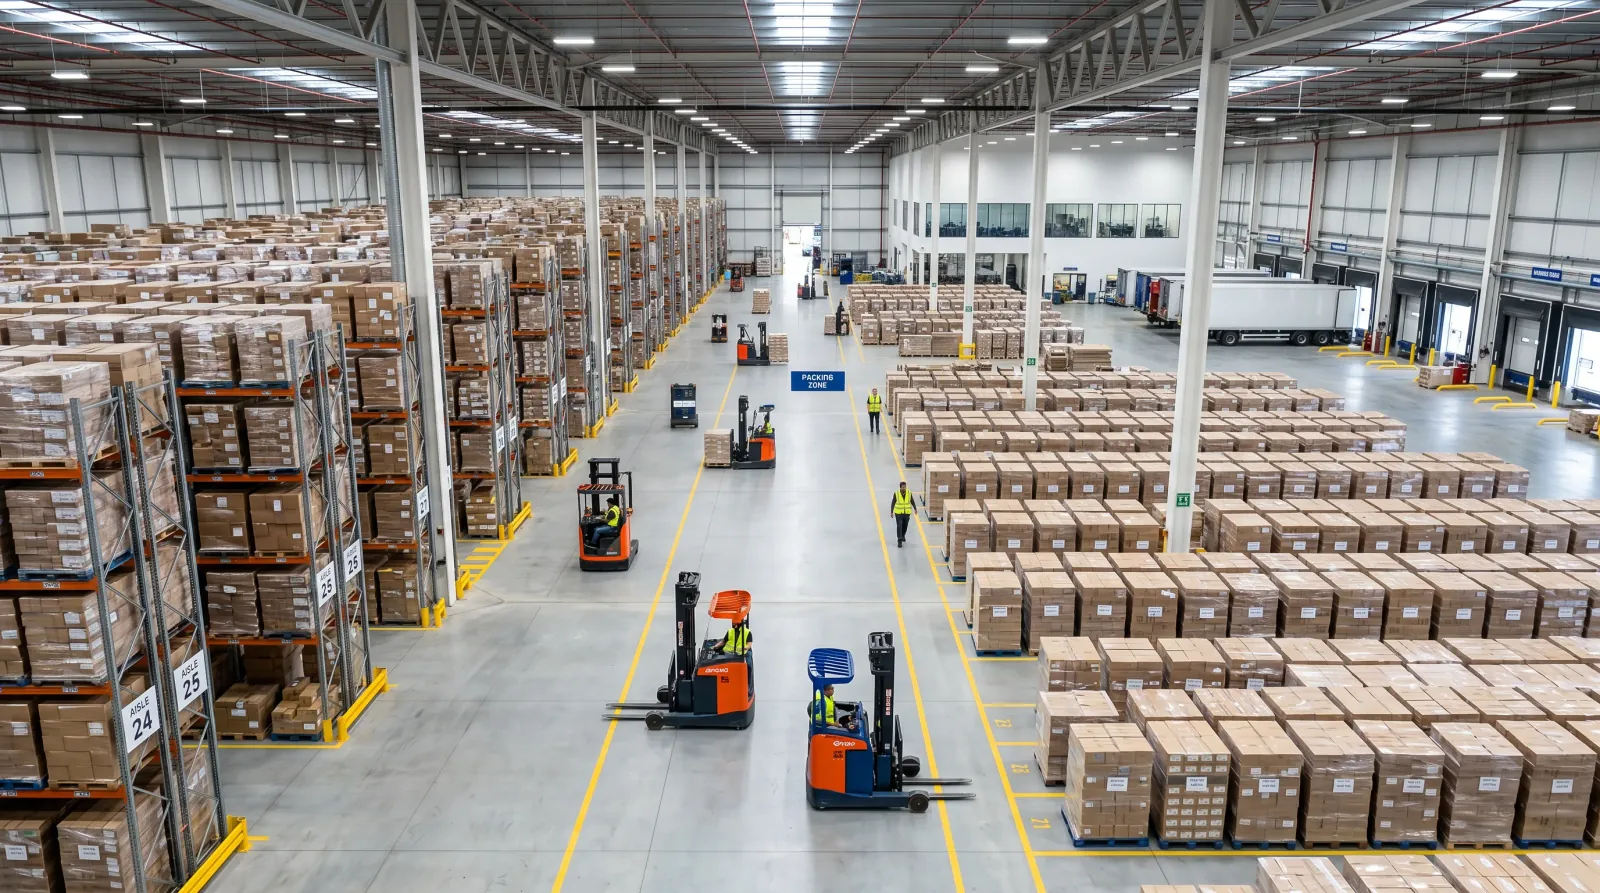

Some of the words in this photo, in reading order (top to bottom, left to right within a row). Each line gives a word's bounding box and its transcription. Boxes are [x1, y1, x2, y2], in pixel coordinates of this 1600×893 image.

[808, 381, 827, 389] ZONE
[348, 555, 358, 575] 25
[321, 579, 332, 599] 25
[181, 659, 199, 678] AISLE
[183, 671, 200, 700] 25
[129, 696, 149, 718] AISLE
[132, 709, 153, 741] 24
